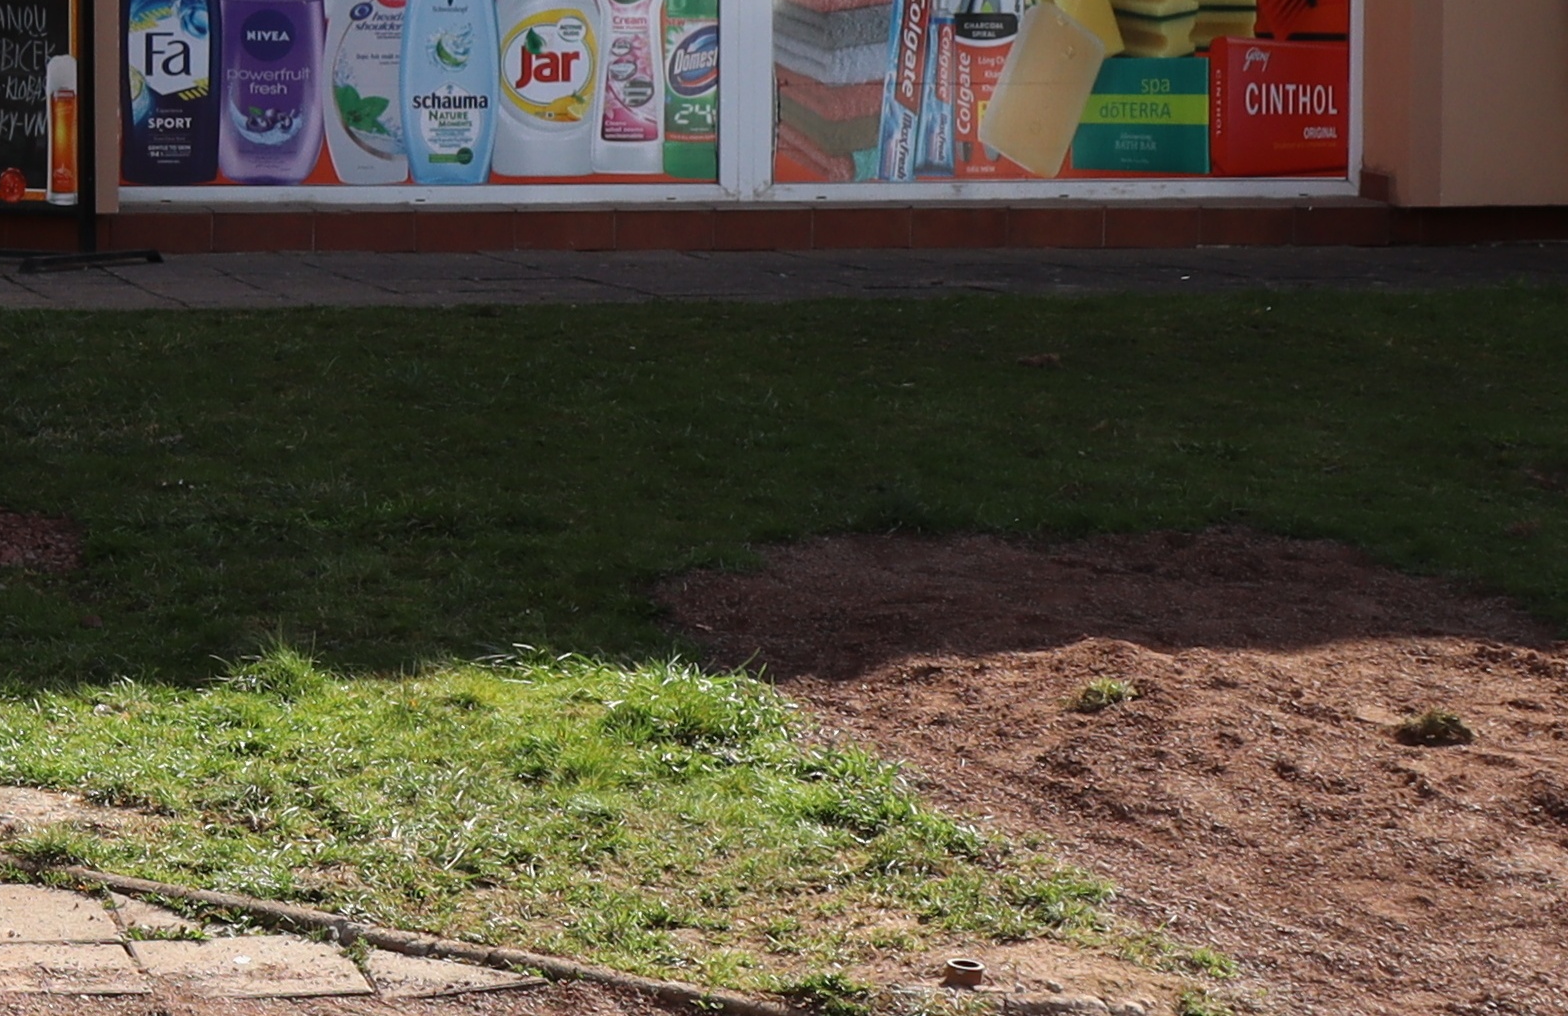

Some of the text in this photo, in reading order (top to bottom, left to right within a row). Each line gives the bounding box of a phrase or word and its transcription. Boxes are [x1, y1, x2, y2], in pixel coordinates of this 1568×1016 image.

[613, 16, 648, 25] Cream
[246, 29, 290, 42] NIVEA
[144, 32, 192, 77] Fa
[937, 25, 953, 100] Colgate
[515, 44, 581, 89] Jar
[227, 66, 312, 88] powerfruit
[1140, 77, 1171, 95] spa
[249, 82, 288, 95] fresh
[956, 51, 975, 135] Colgate
[411, 91, 489, 110] schauma
[1244, 81, 1338, 116] CINTHOL
[147, 117, 192, 129] SPORT
[1302, 126, 1338, 140] ORIGINAL
